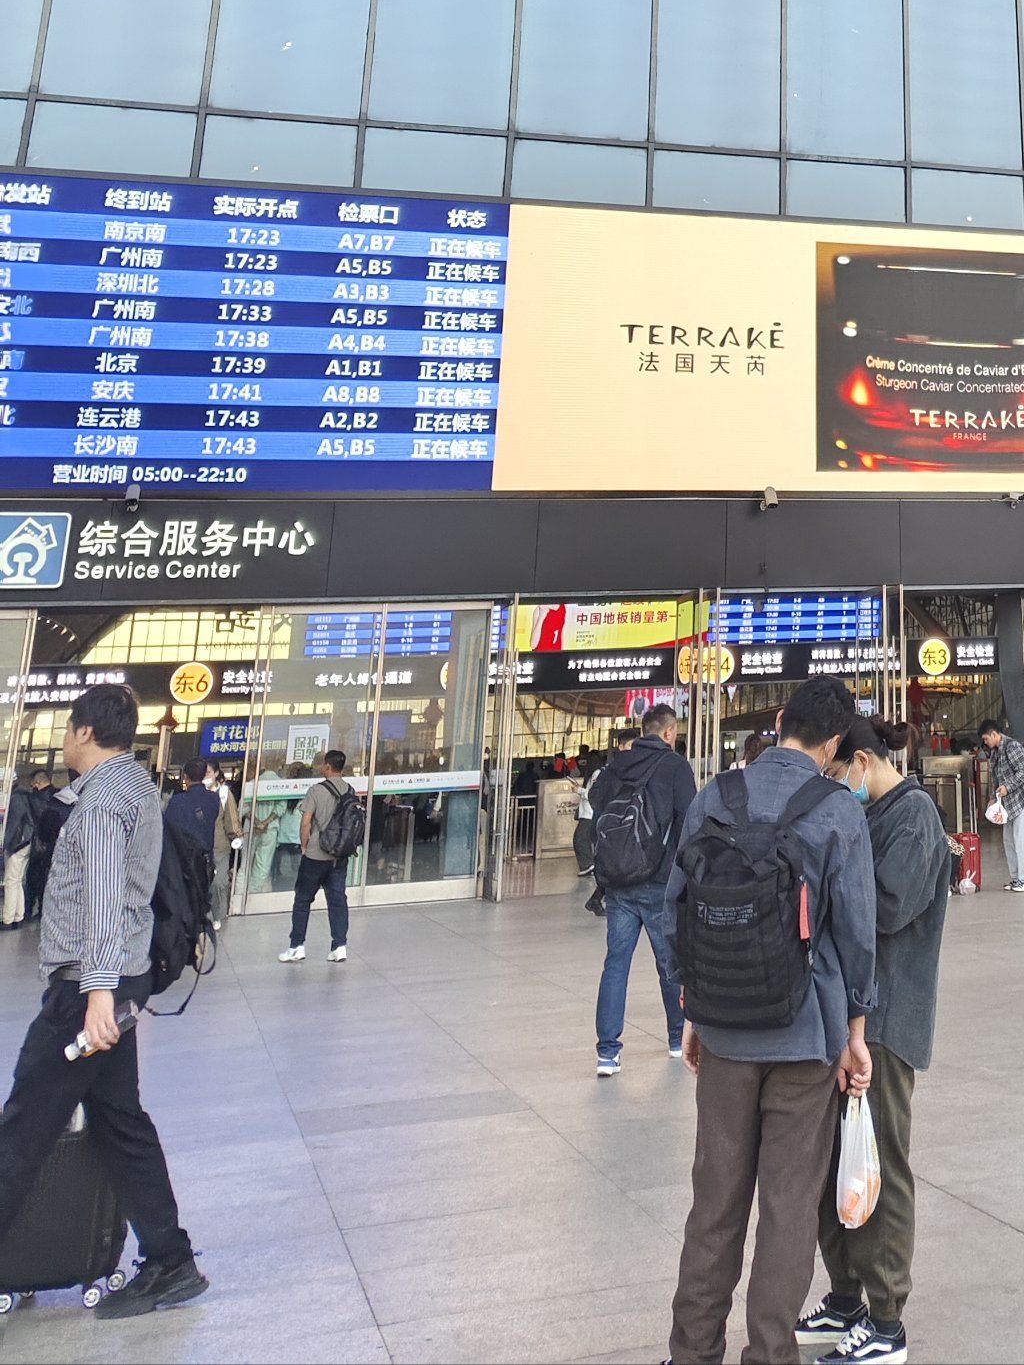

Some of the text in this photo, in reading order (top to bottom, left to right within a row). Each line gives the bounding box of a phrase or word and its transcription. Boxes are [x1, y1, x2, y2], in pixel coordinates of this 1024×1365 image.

[105, 189, 172, 211] 终到站
[214, 196, 298, 218] 实际开点
[338, 203, 399, 224] 检票口
[447, 210, 486, 228] 状态
[104, 221, 501, 259] 南京南 17:23 A7,B7 正在候车
[100, 247, 163, 267] 广州南
[225, 253, 277, 270] 17:23
[336, 259, 391, 275] A5,B5
[427, 263, 499, 282] 正在候车
[97, 273, 498, 307] 深圳北 17:28 A3,B3 正在候车
[93, 299, 156, 319] 广州南
[218, 305, 271, 321] 17:33
[331, 309, 387, 326] A5,B5
[423, 312, 496, 330] 正在候车
[89, 326, 494, 357] 广州南 17:38 A4,B4 正在候车
[95, 353, 492, 380] 北京 17:39 A1,B1 正在候车
[638, 352, 766, 376] 法国天芮
[866, 356, 895, 371] Crème
[897, 360, 953, 376] Concentré
[956, 364, 971, 376] de
[974, 363, 1008, 376] Caviar
[92, 380, 491, 407] 安庆 17:41 A8,B8 正在候车
[875, 374, 917, 392] Sturgeon
[920, 379, 953, 392] Caviar
[77, 408, 489, 432] 连云港 17:43 A2,B2 正在候车
[74, 435, 487, 459] 长沙南 17:43 A5,B5 正在候车
[953, 433, 987, 442] FRANCE
[53, 464, 247, 484] 营业时间 05:00--22:10
[78, 520, 315, 558] 综合服务中心
[74, 561, 241, 580] Service Center
[922, 649, 947, 666] 东3
[957, 645, 994, 658] 安全检查
[174, 673, 209, 694] 东6
